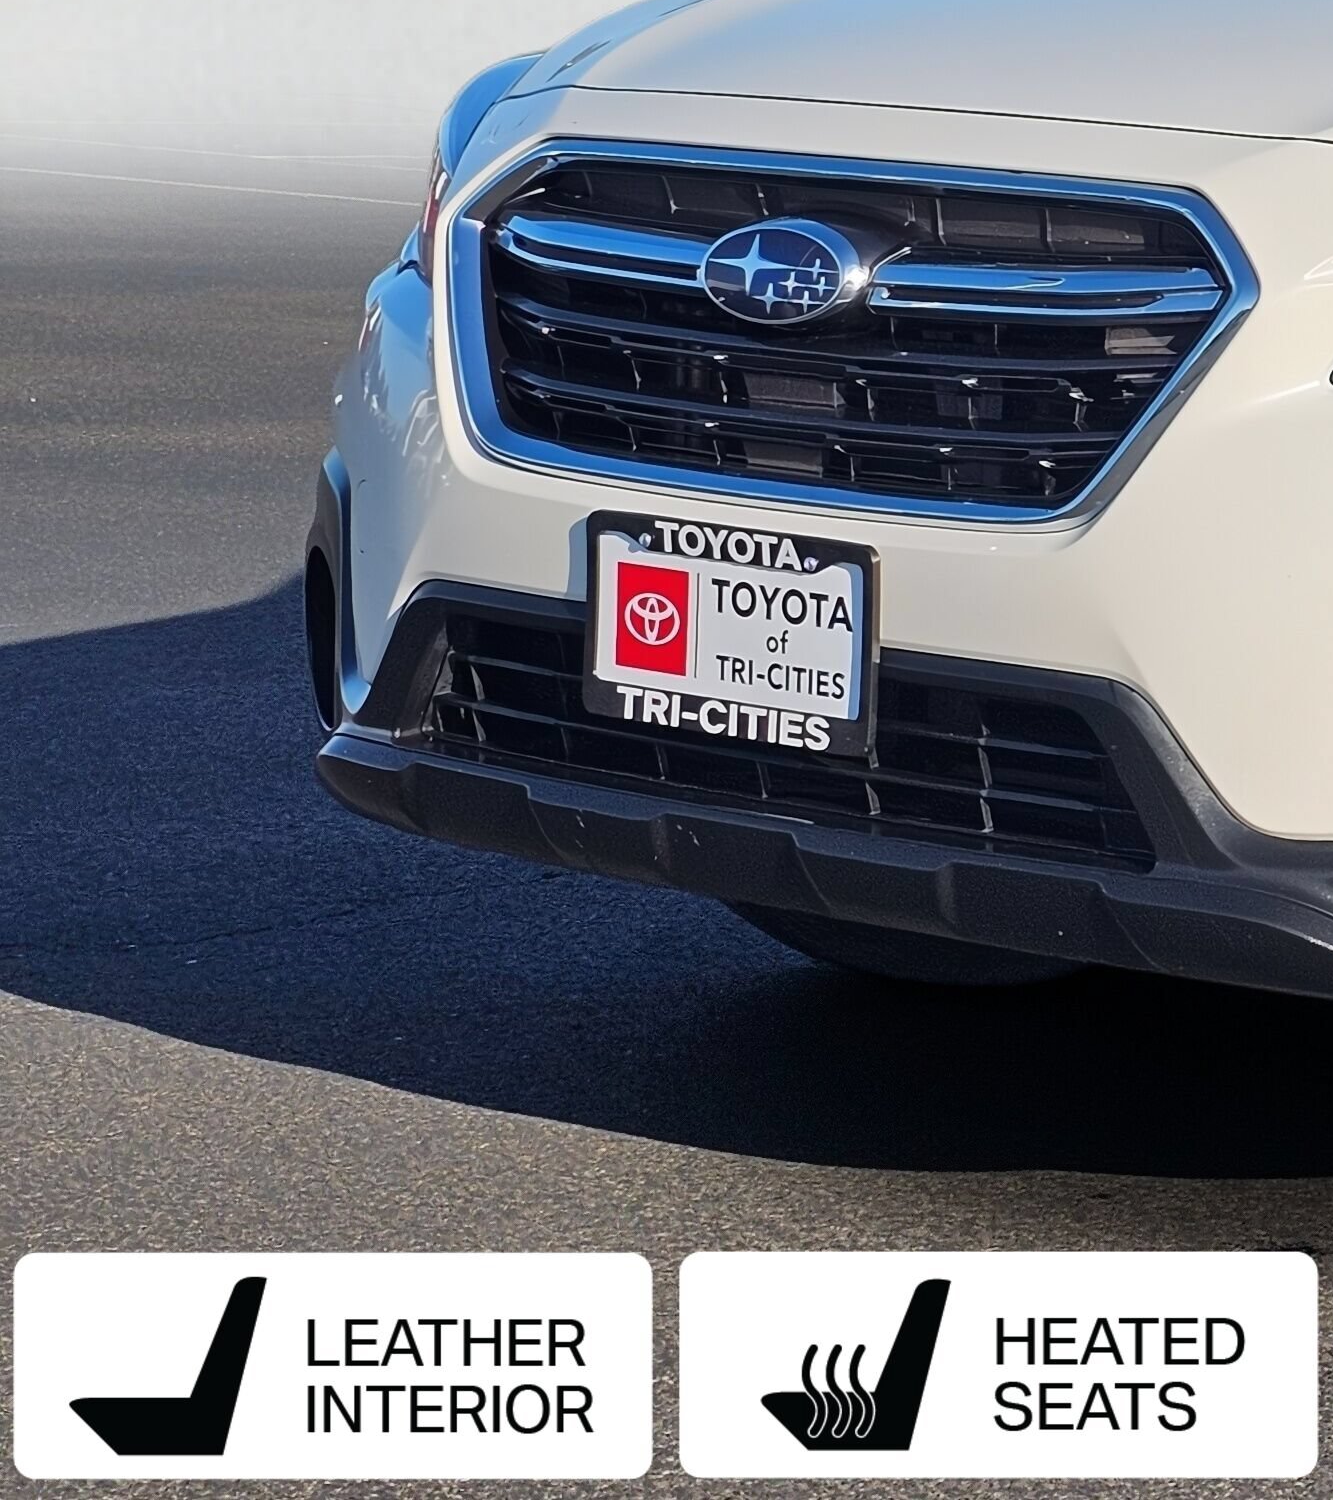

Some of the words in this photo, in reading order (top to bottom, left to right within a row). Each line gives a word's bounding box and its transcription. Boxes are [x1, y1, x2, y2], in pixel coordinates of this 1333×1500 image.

[655, 521, 802, 571] TOYOTA
[711, 578, 853, 632] TOYOTA
[766, 630, 788, 654] of
[716, 655, 845, 699] TRI-CITIES
[616, 686, 831, 751] TRI-CITIES
